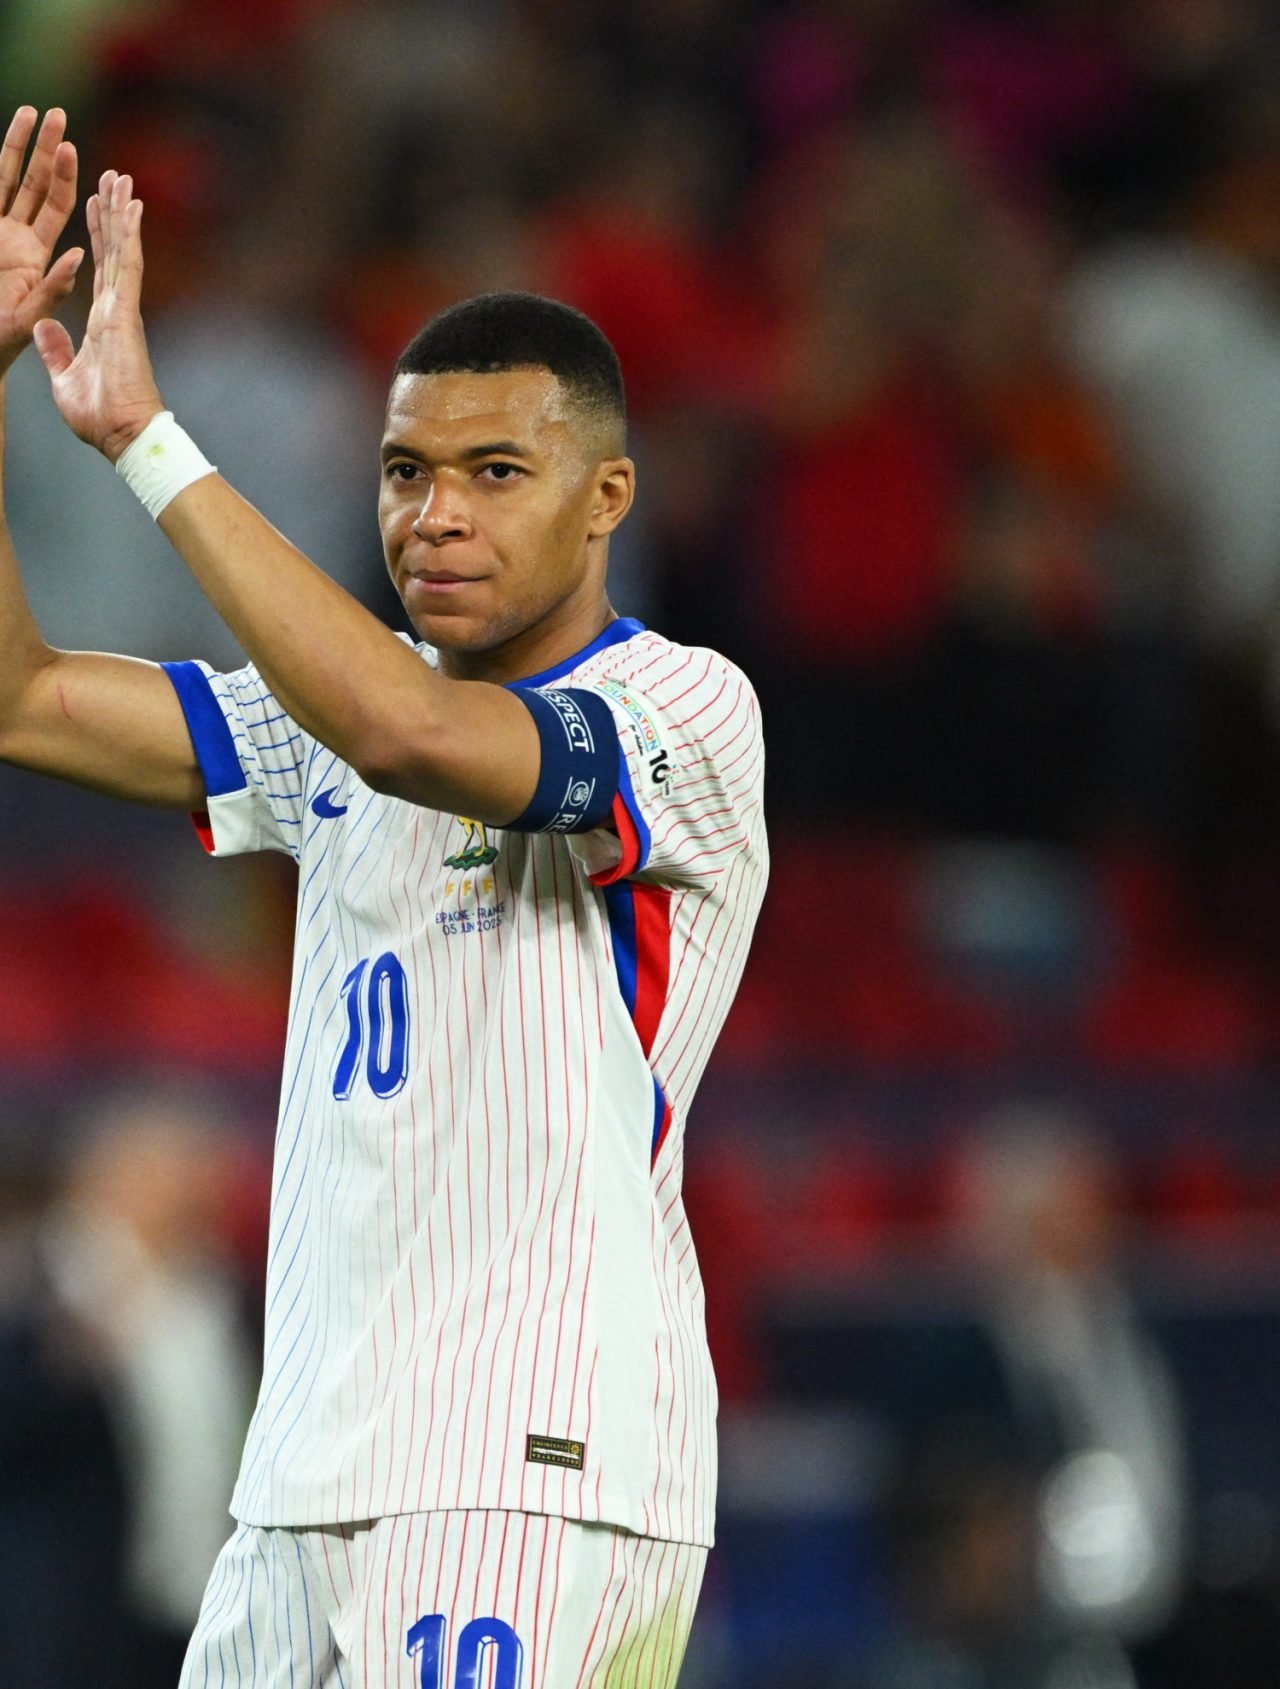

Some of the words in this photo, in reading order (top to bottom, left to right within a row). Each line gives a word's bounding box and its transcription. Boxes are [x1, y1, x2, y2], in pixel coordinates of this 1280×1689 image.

[539, 689, 590, 752] ESPECT
[596, 681, 658, 751] FOUNDATION
[442, 924, 458, 936] 05
[333, 950, 410, 1101] 10
[406, 1614, 524, 1689] 10
